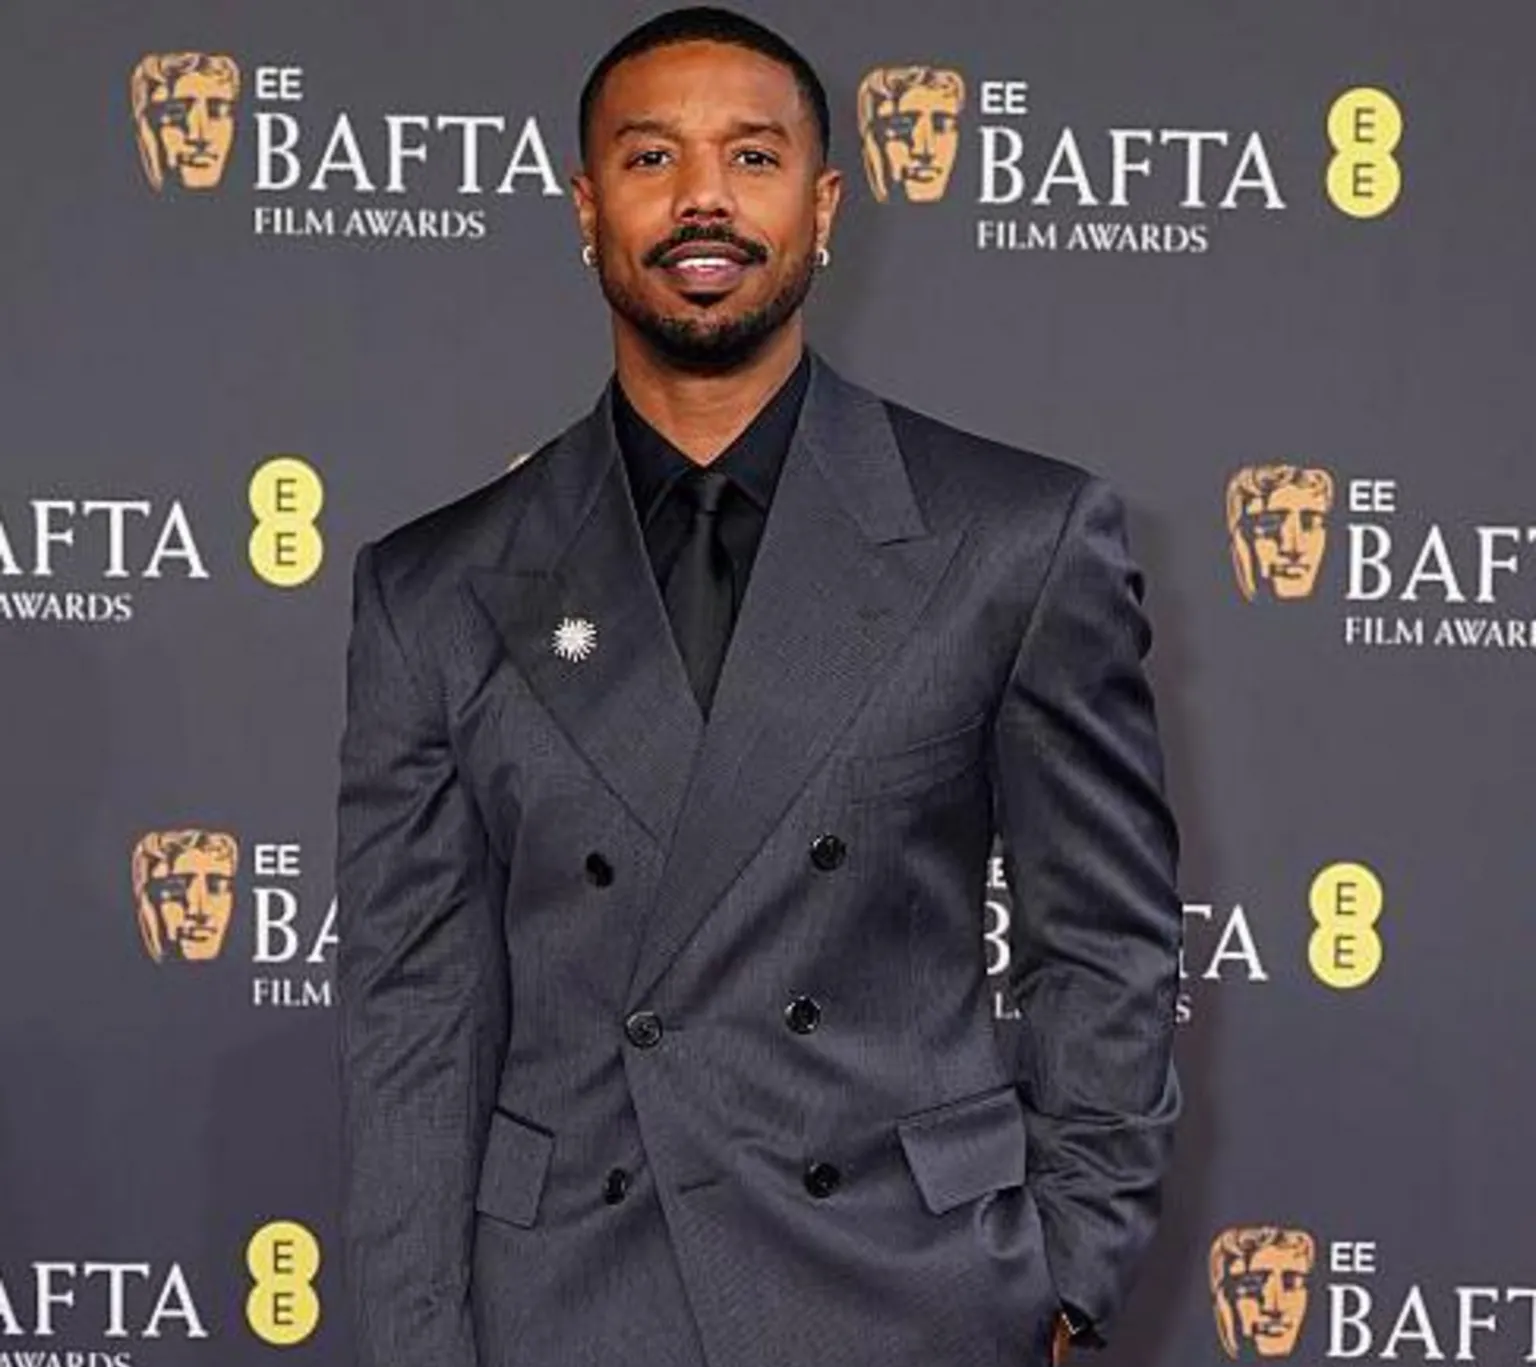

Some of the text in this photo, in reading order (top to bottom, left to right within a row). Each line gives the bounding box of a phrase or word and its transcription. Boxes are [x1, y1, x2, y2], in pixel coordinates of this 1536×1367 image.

[255, 66, 303, 101] EE
[980, 81, 1028, 115] EE
[254, 112, 564, 196] BAFTA
[978, 125, 1287, 210] BAFTA
[254, 207, 486, 238] FILM AWARDS
[977, 220, 1208, 253] FILM AWARDS
[1349, 479, 1396, 513] EE
[1345, 523, 1536, 603] BAF
[1345, 616, 1536, 648] FILM AWAR
[254, 843, 301, 877] EE
[253, 979, 331, 1007] FILM
[1330, 1241, 1376, 1273] EE
